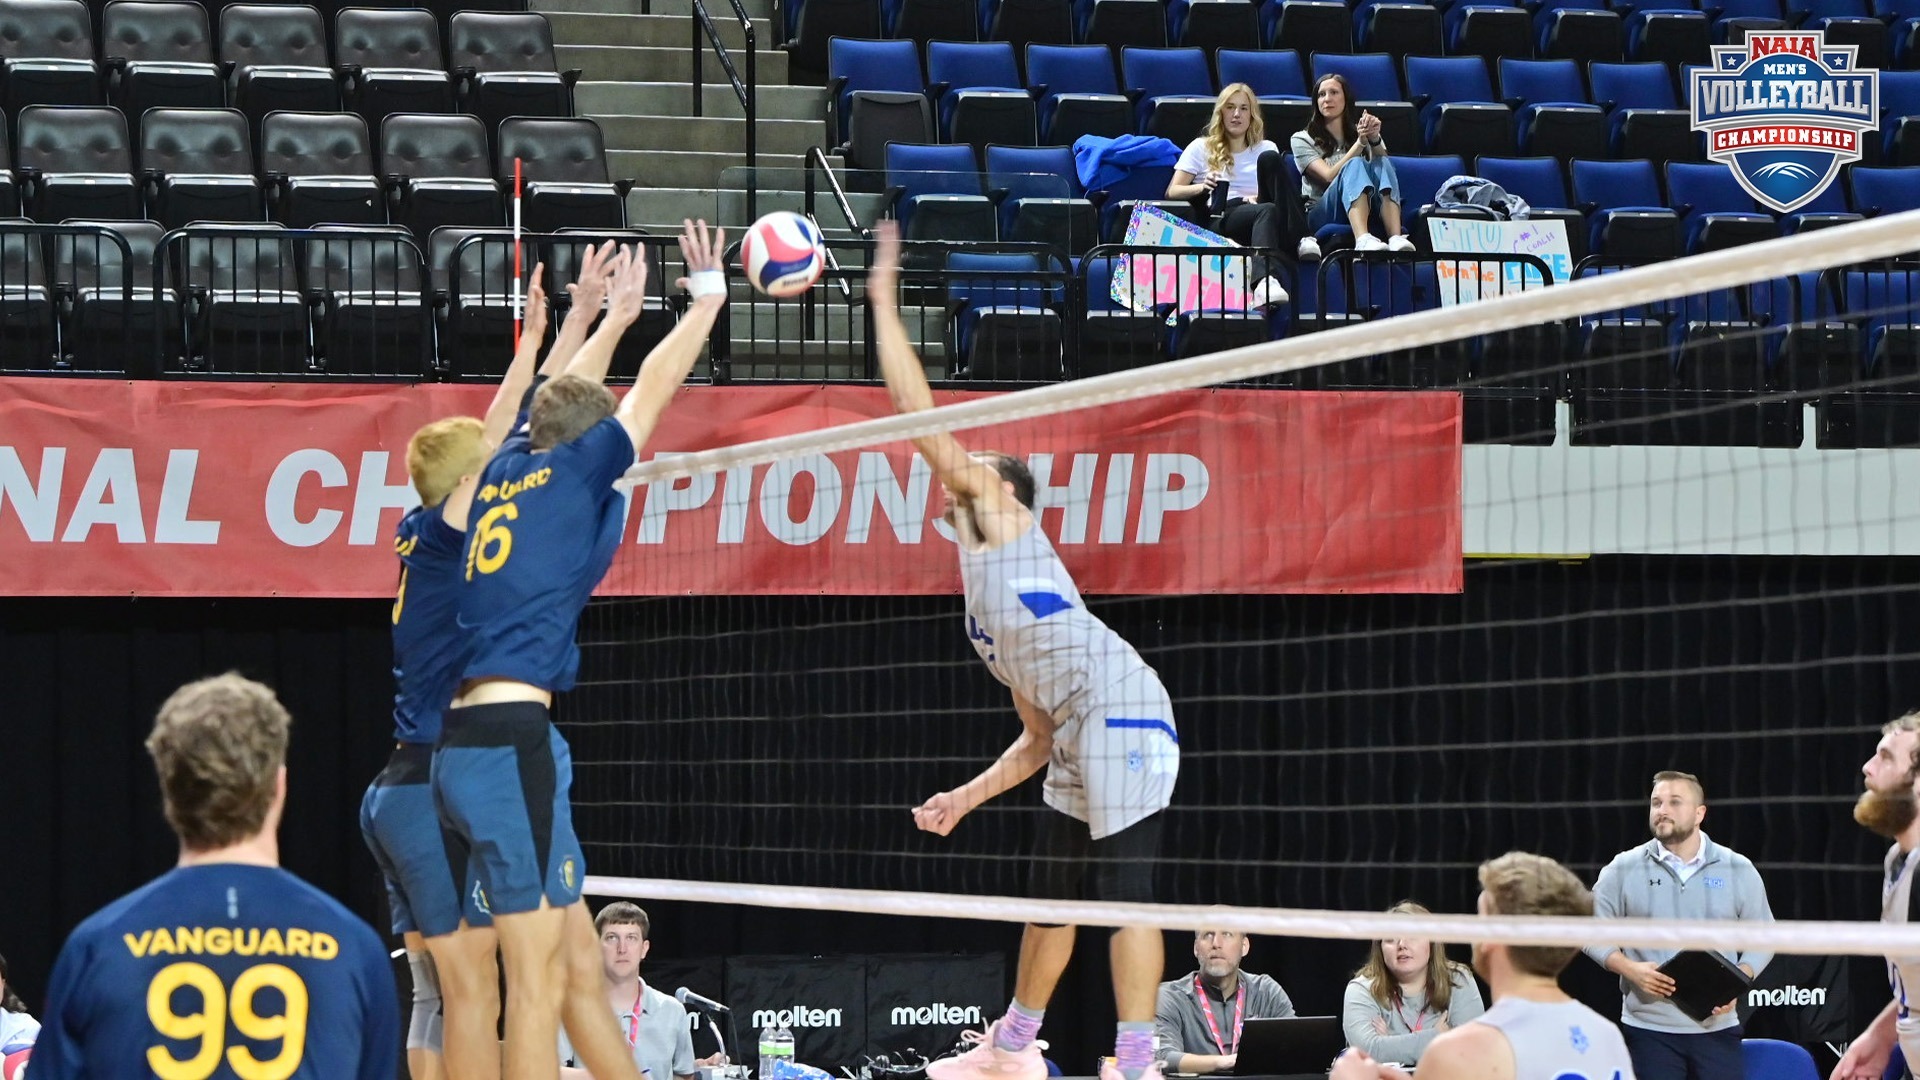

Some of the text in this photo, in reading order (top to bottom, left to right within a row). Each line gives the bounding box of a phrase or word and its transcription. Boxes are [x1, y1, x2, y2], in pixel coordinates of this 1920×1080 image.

[264, 448, 1210, 545] CHPIONHIP
[123, 927, 339, 960] VANGUARD
[1748, 985, 1827, 1007] molten
[146, 961, 309, 1080] 99
[752, 1005, 842, 1028] molten
[891, 1003, 980, 1025] molten
